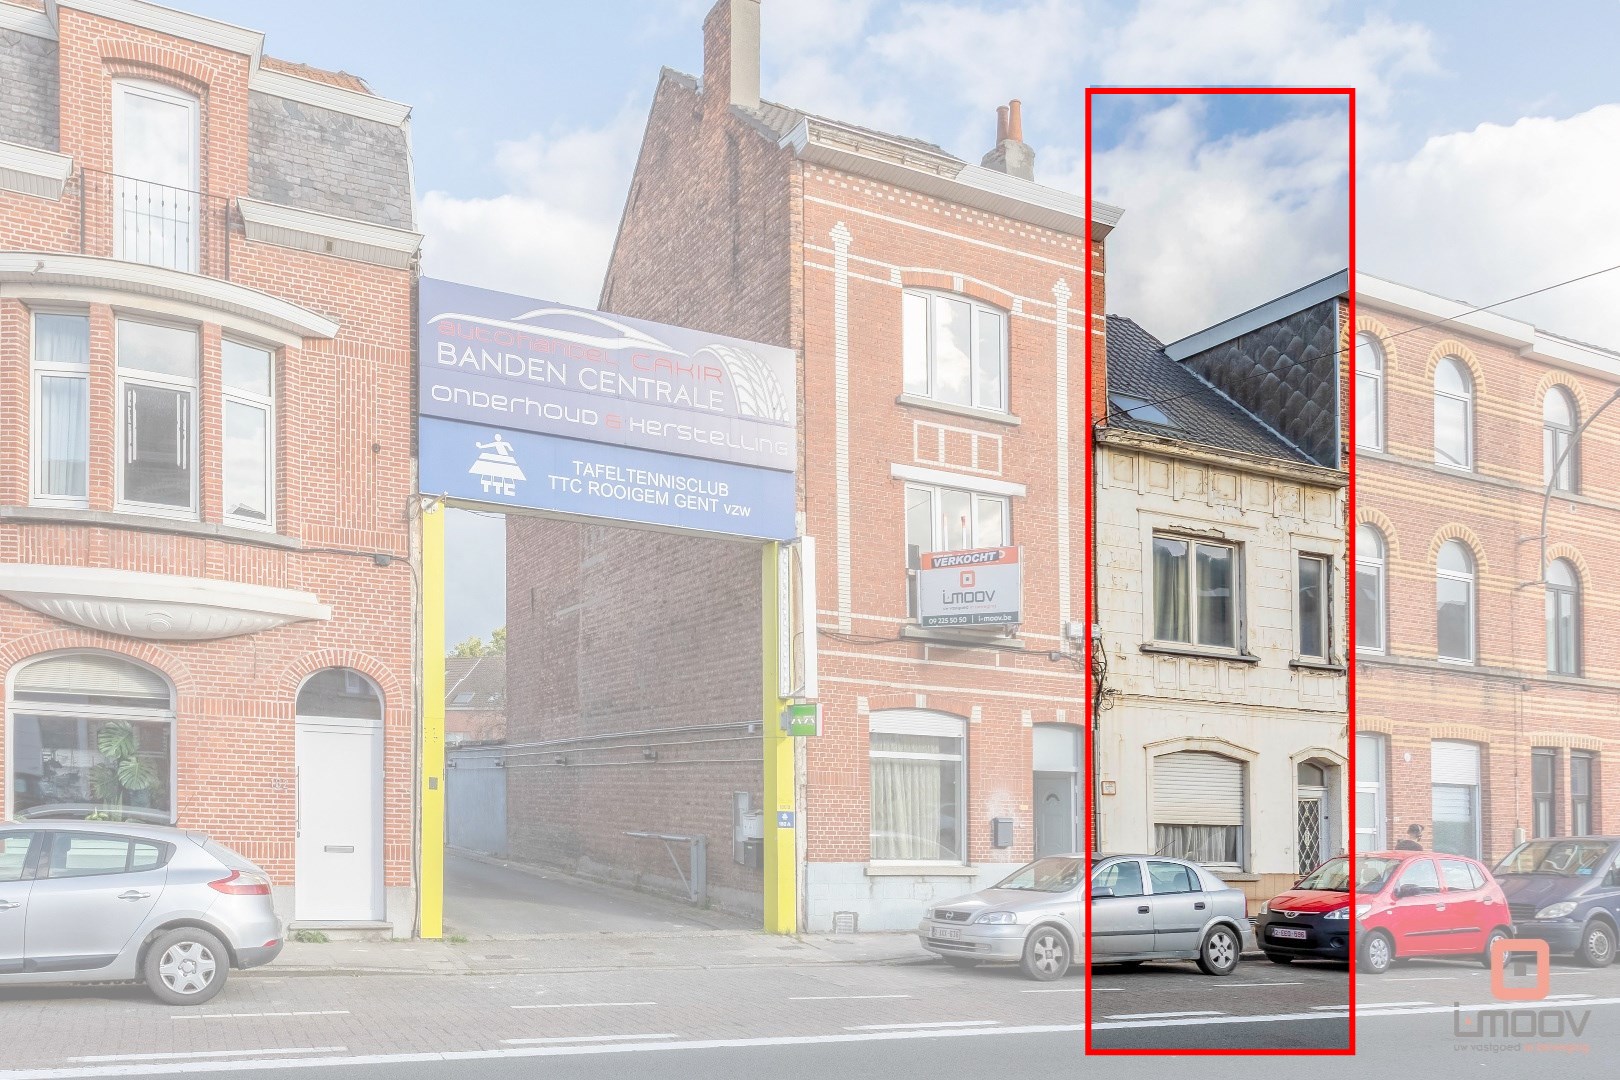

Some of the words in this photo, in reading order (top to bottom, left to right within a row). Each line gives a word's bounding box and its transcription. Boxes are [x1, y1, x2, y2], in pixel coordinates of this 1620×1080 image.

[437, 341, 567, 386] BANDEN
[578, 367, 724, 412] CENTRALE
[632, 353, 723, 384] CAKIR
[480, 479, 516, 497] TTC
[548, 475, 582, 494] TTC
[588, 481, 669, 506] ROOIGEM
[674, 493, 719, 513] GENT
[572, 460, 729, 497] TAFELTENNISCLUB
[933, 551, 997, 568] VERKOCHT
[949, 616, 958, 624] 50
